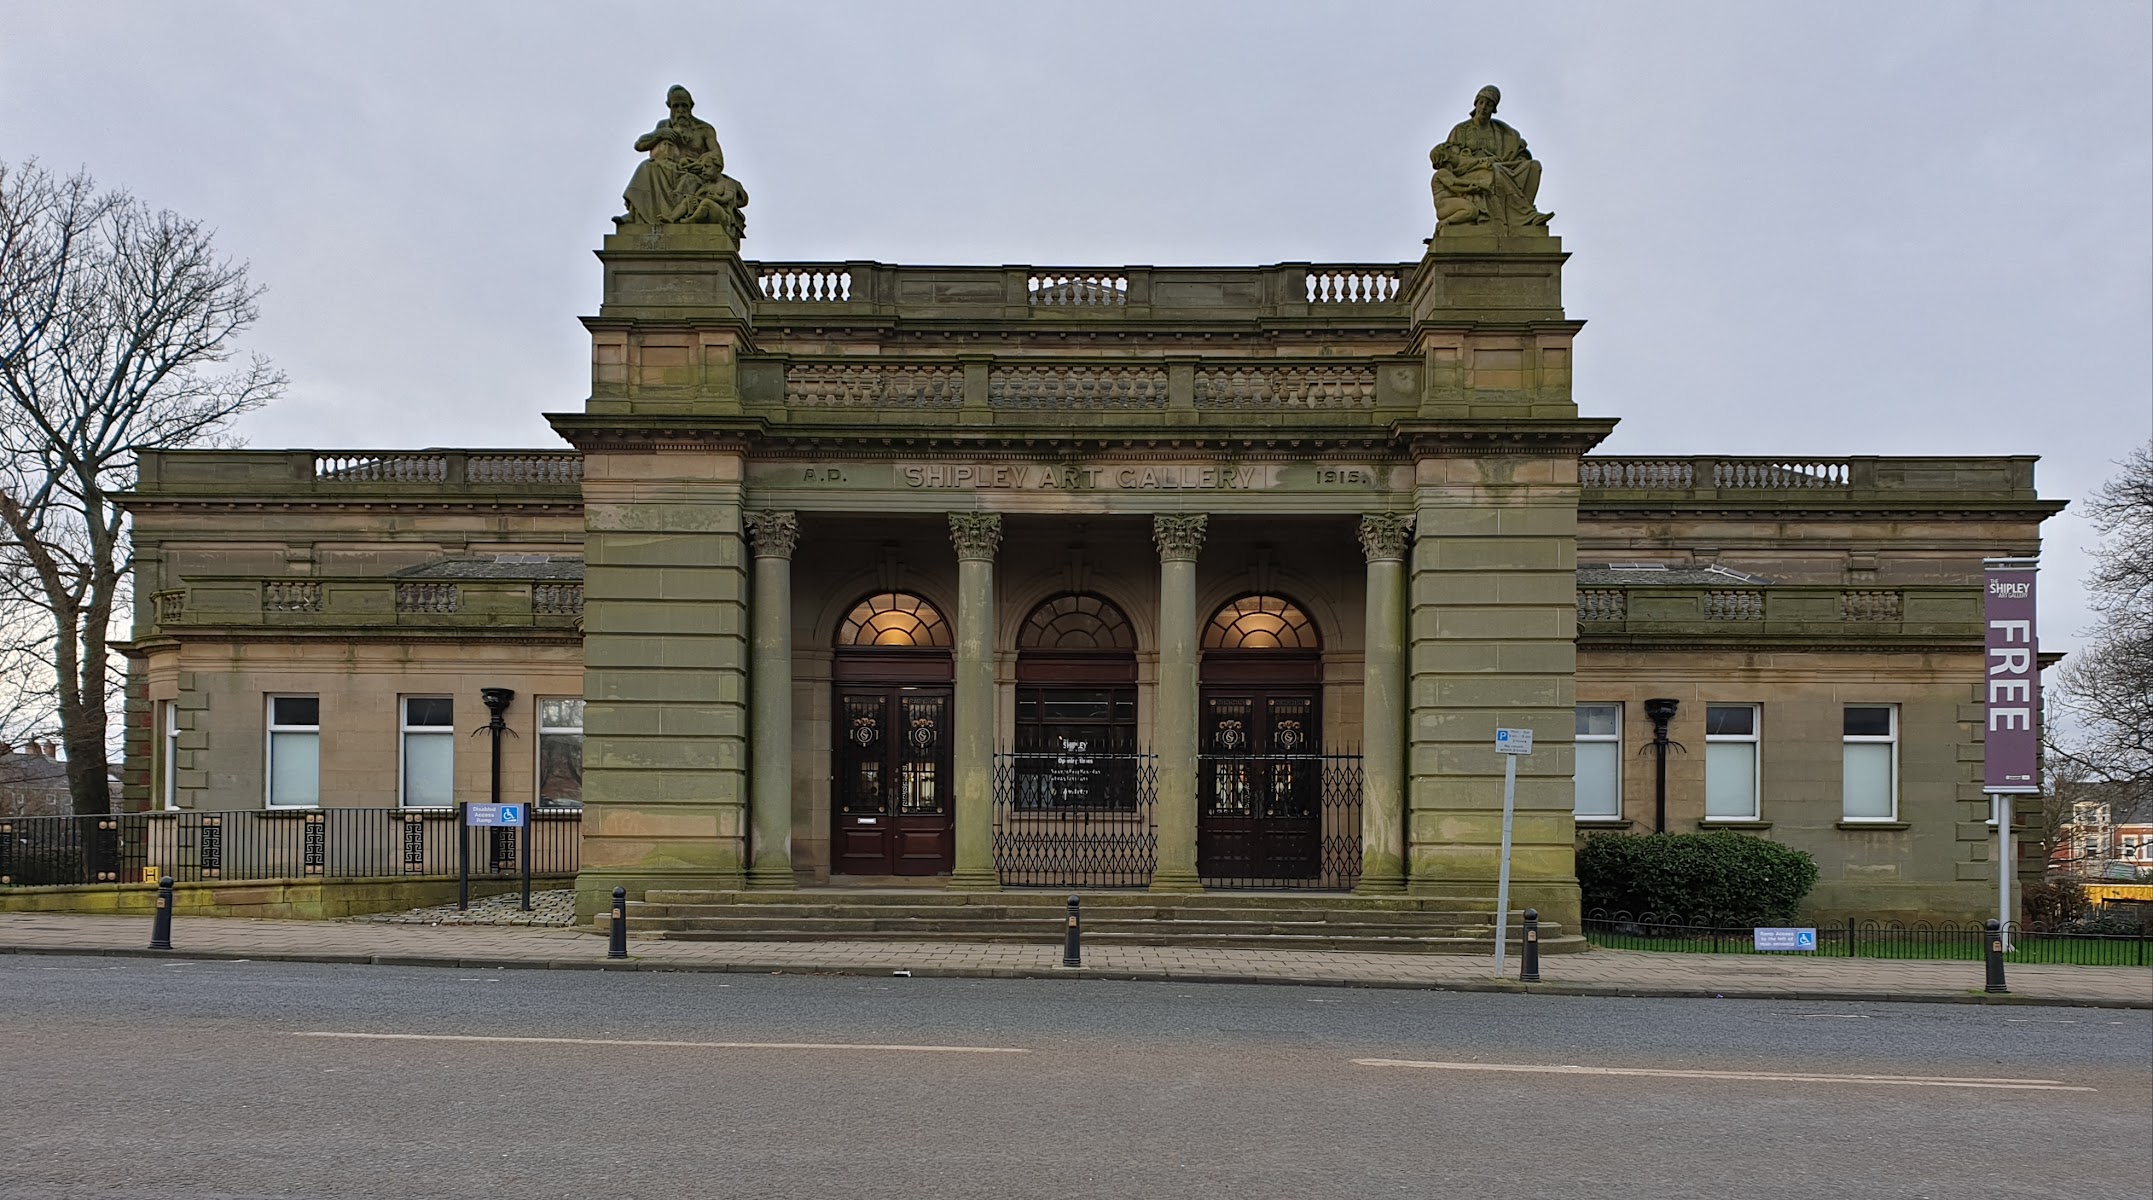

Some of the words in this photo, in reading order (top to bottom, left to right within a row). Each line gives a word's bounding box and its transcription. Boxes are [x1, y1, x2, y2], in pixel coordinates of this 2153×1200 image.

[803, 468, 849, 483] A.D.
[903, 465, 1031, 488] SHIPLEY
[1038, 465, 1104, 489] ART
[1115, 467, 1256, 489] GALLERY
[1990, 583, 2030, 594] SHIPLEY
[1990, 620, 2030, 731] FREE
[145, 869, 156, 881] H
